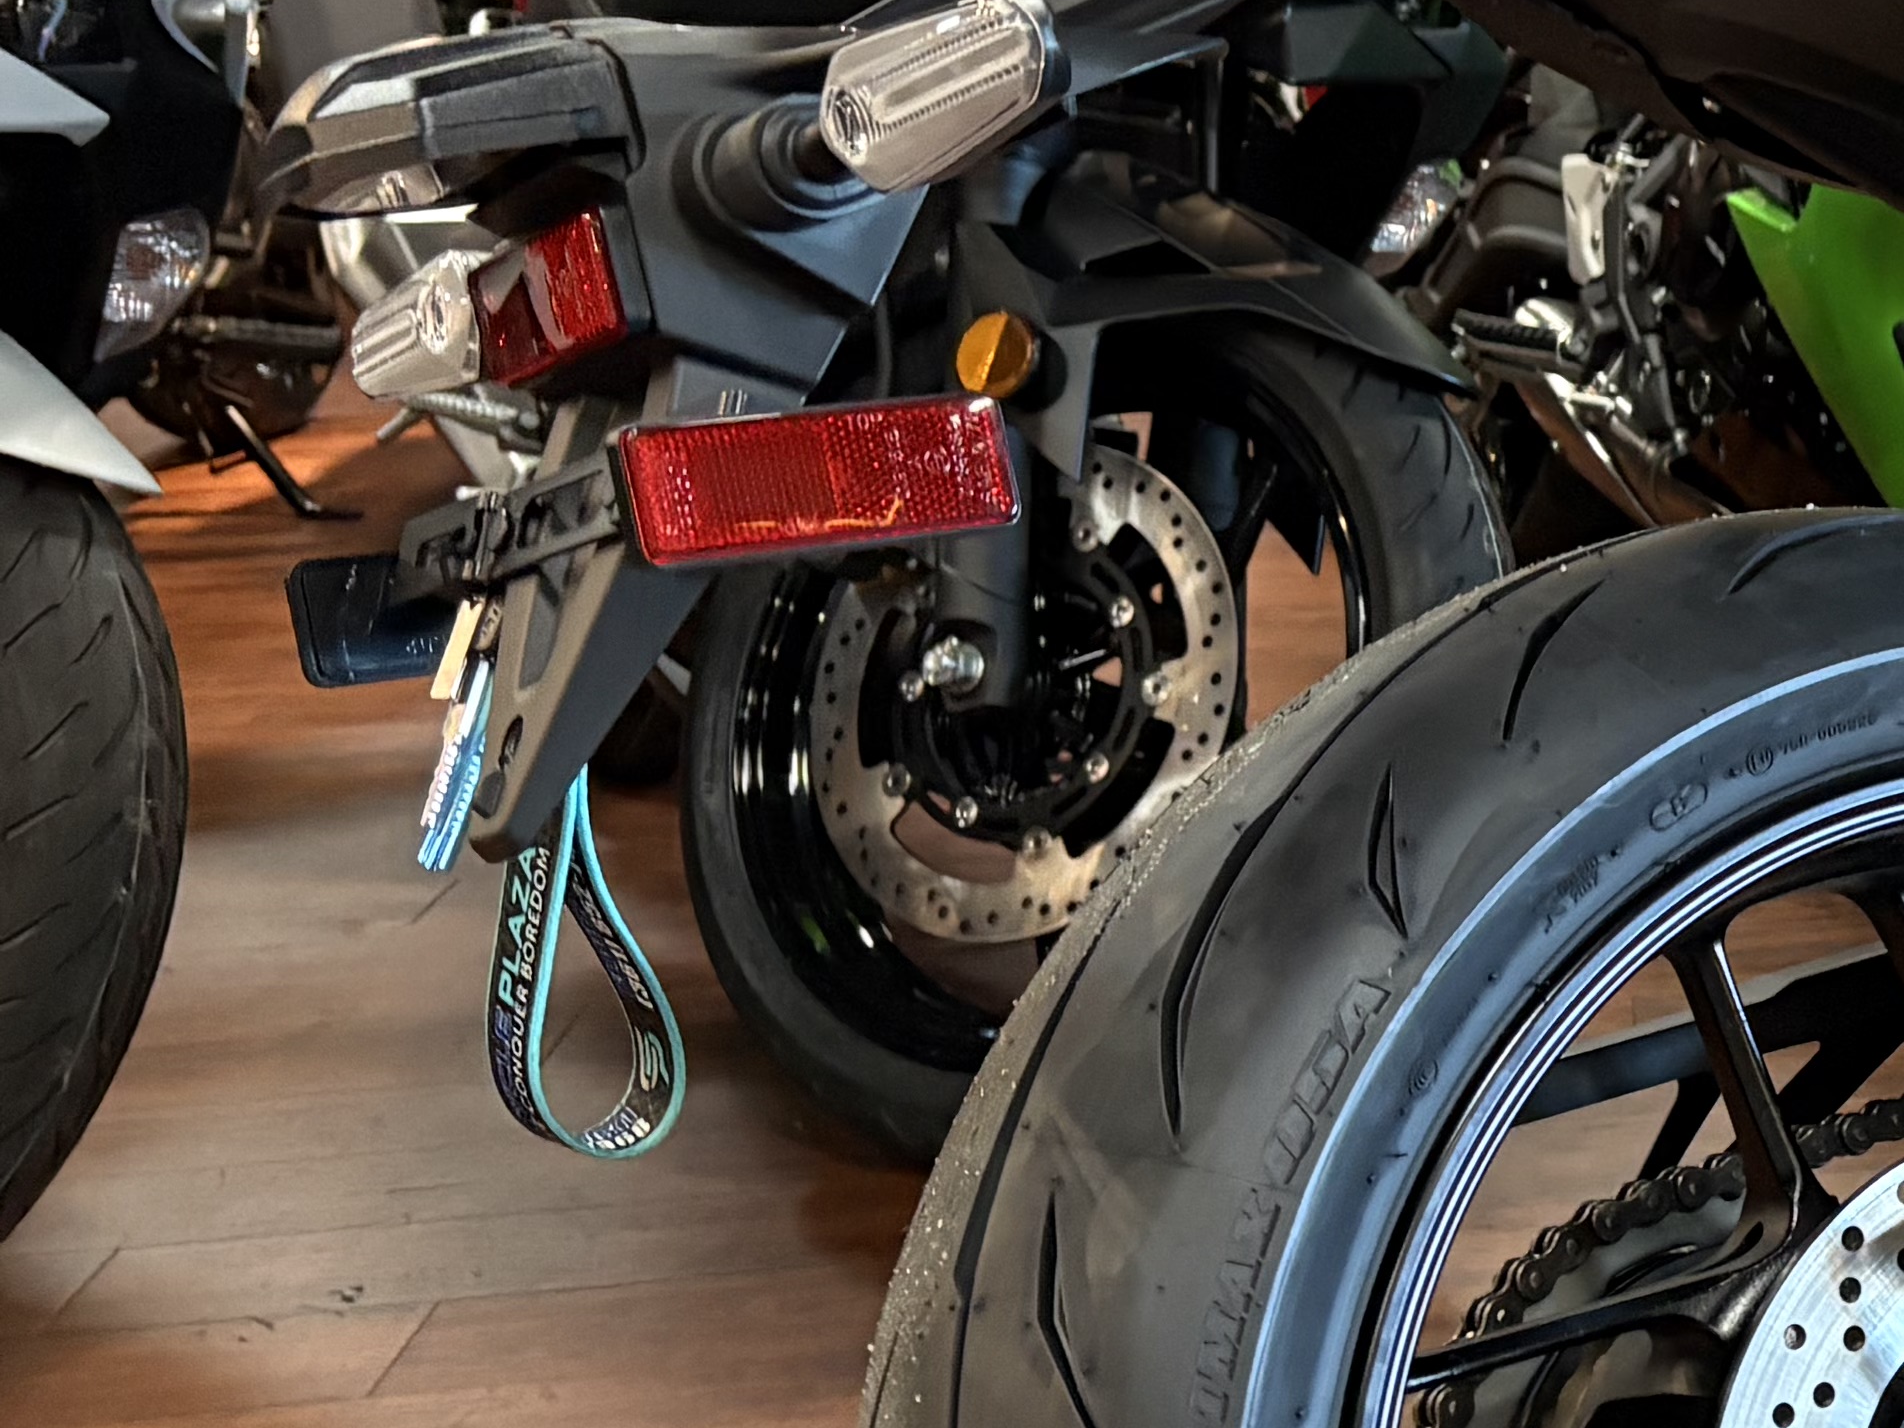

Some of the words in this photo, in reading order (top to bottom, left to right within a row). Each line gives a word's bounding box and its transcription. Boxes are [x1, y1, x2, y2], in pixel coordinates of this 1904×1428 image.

[498, 845, 537, 1008] PLAZA
[520, 847, 550, 982] BOREDOM
[509, 983, 536, 1114] CONQUER
